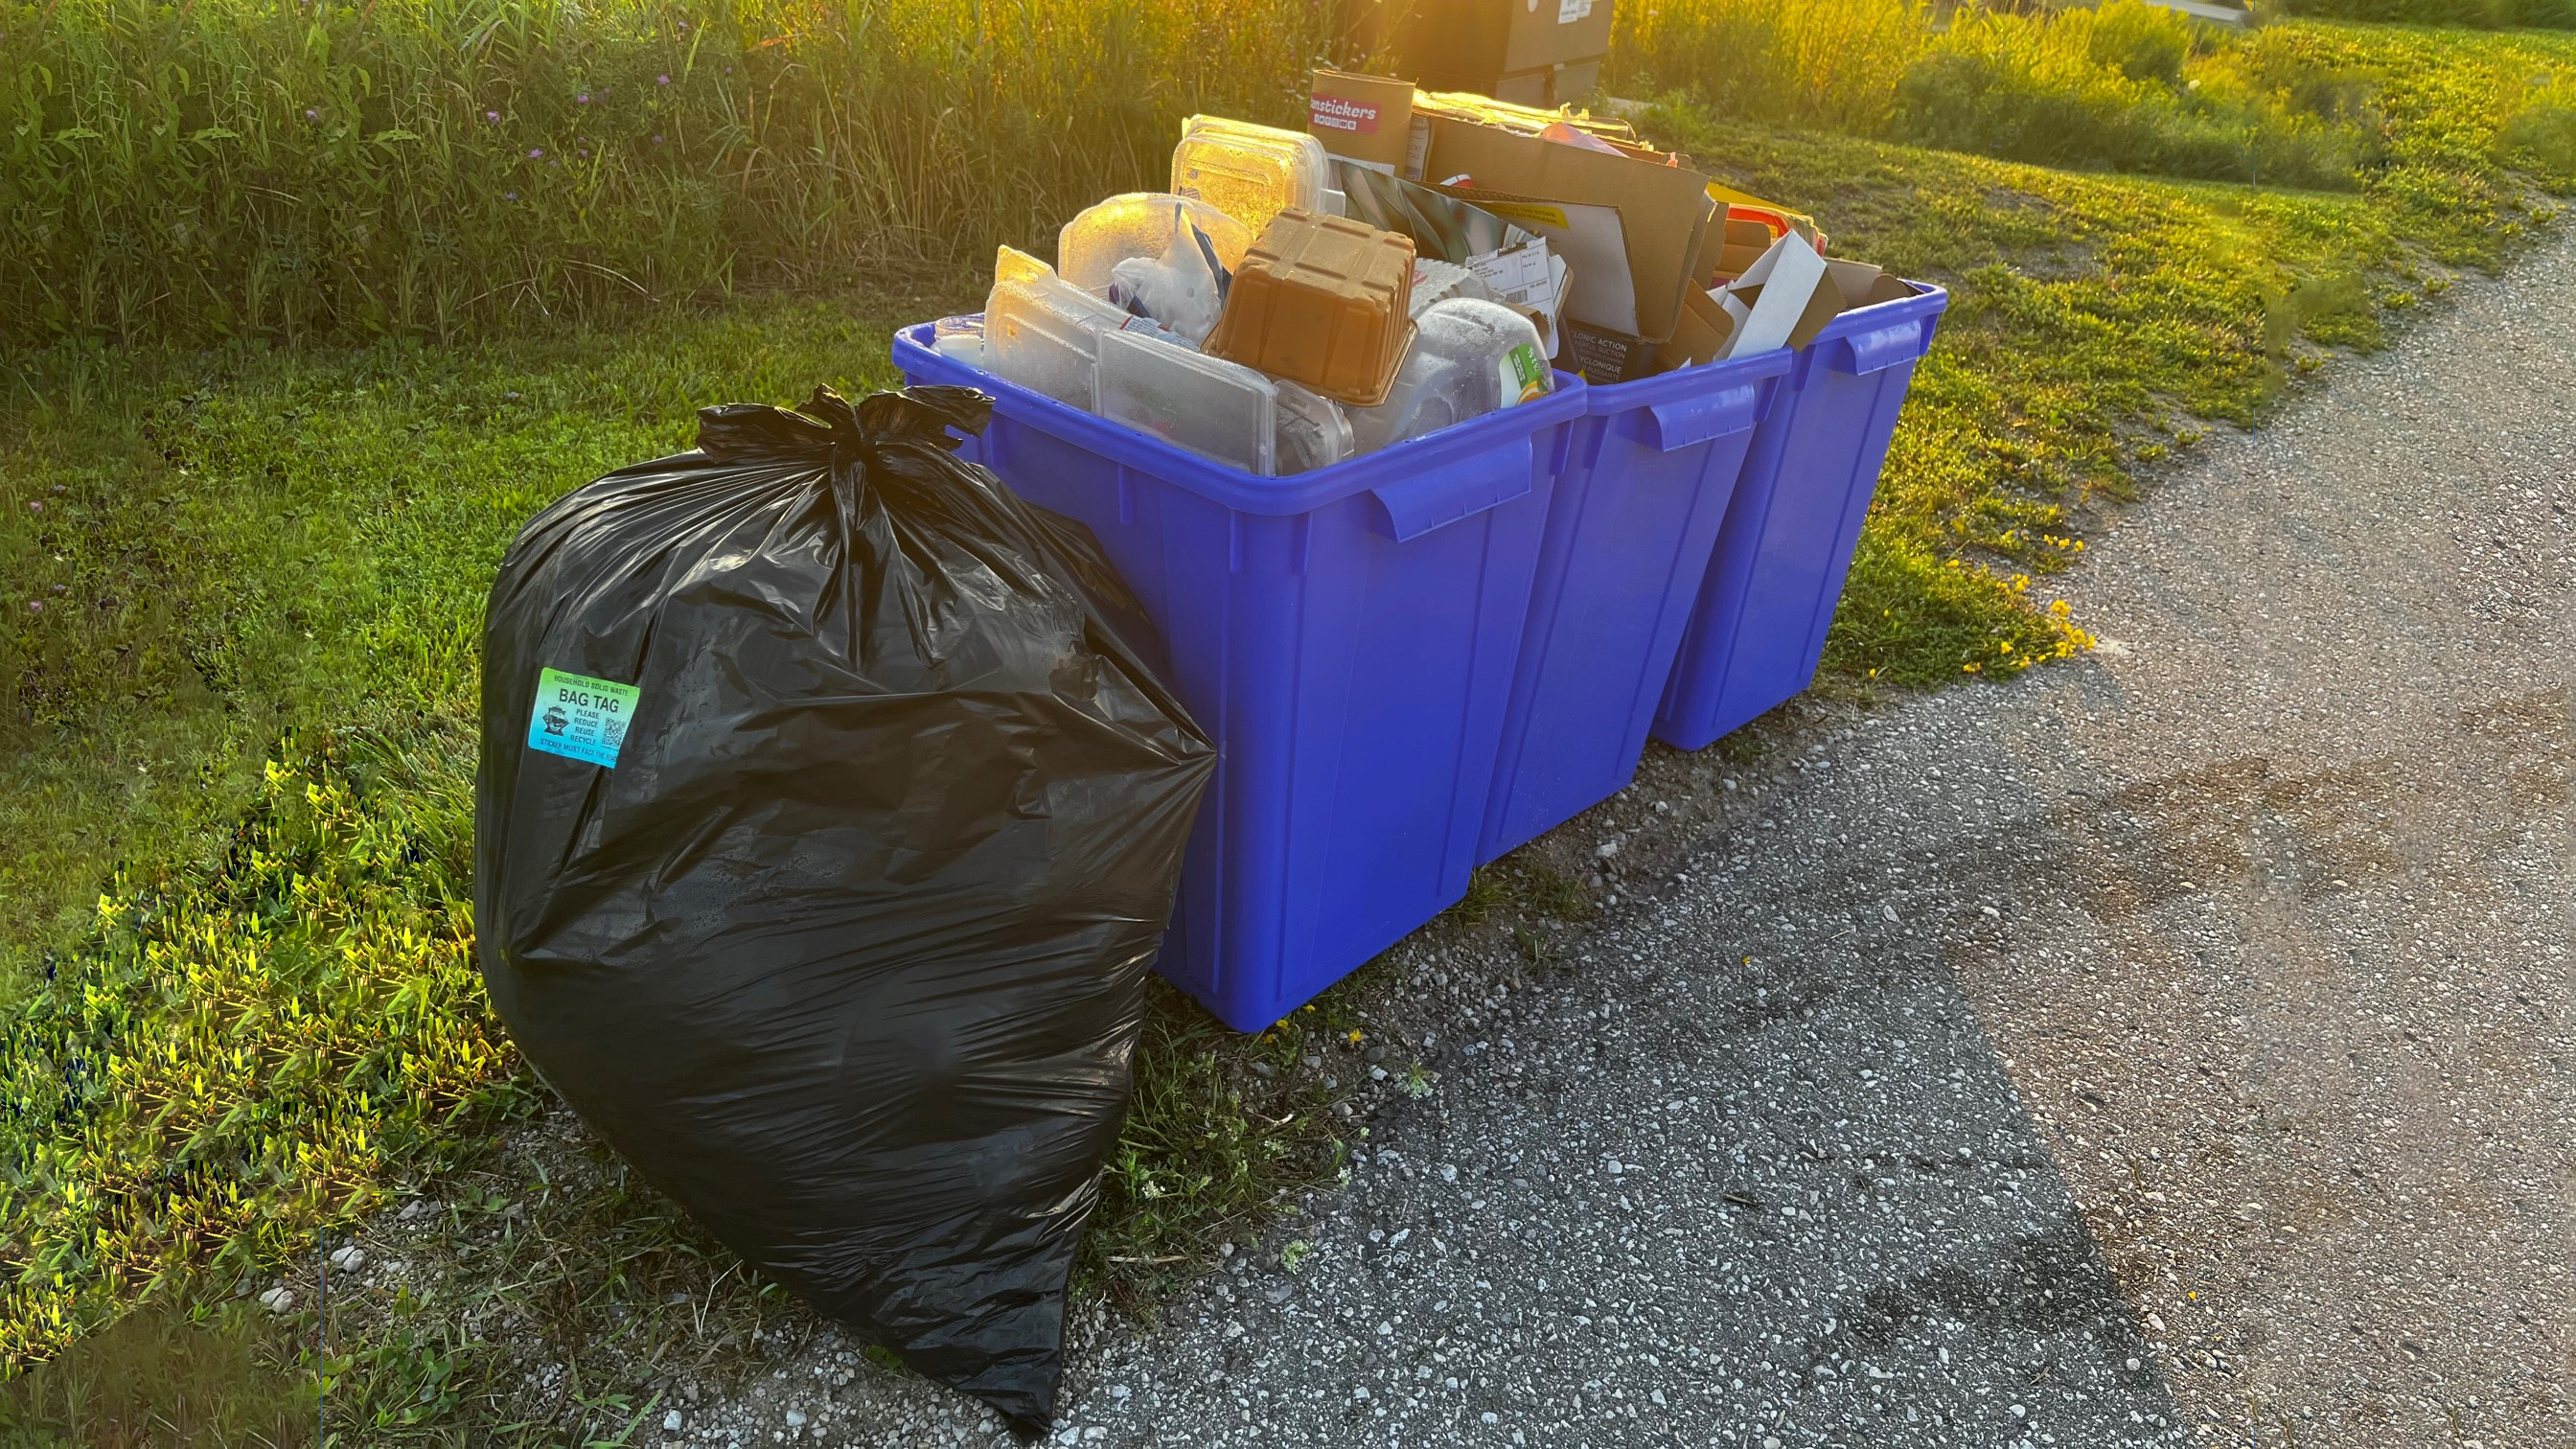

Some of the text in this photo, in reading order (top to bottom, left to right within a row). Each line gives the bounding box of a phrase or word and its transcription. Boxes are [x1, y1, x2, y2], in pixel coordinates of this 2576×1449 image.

[1534, 209, 1556, 218] STORE
[1598, 338, 1627, 352] ACTION
[1598, 346, 1626, 359] SUCTION
[554, 675, 629, 697] HOUSEHOLD SOLID WASTE
[559, 688, 620, 713] BAG TAG
[576, 708, 599, 720] PLEASE
[574, 718, 598, 728] REDUCE
[575, 726, 595, 736] REUSE
[569, 735, 597, 747] RECYCLE
[540, 738, 563, 749] STICKER
[564, 743, 581, 753] MUST
[582, 747, 595, 756] FACE
[596, 750, 606, 760] THE
